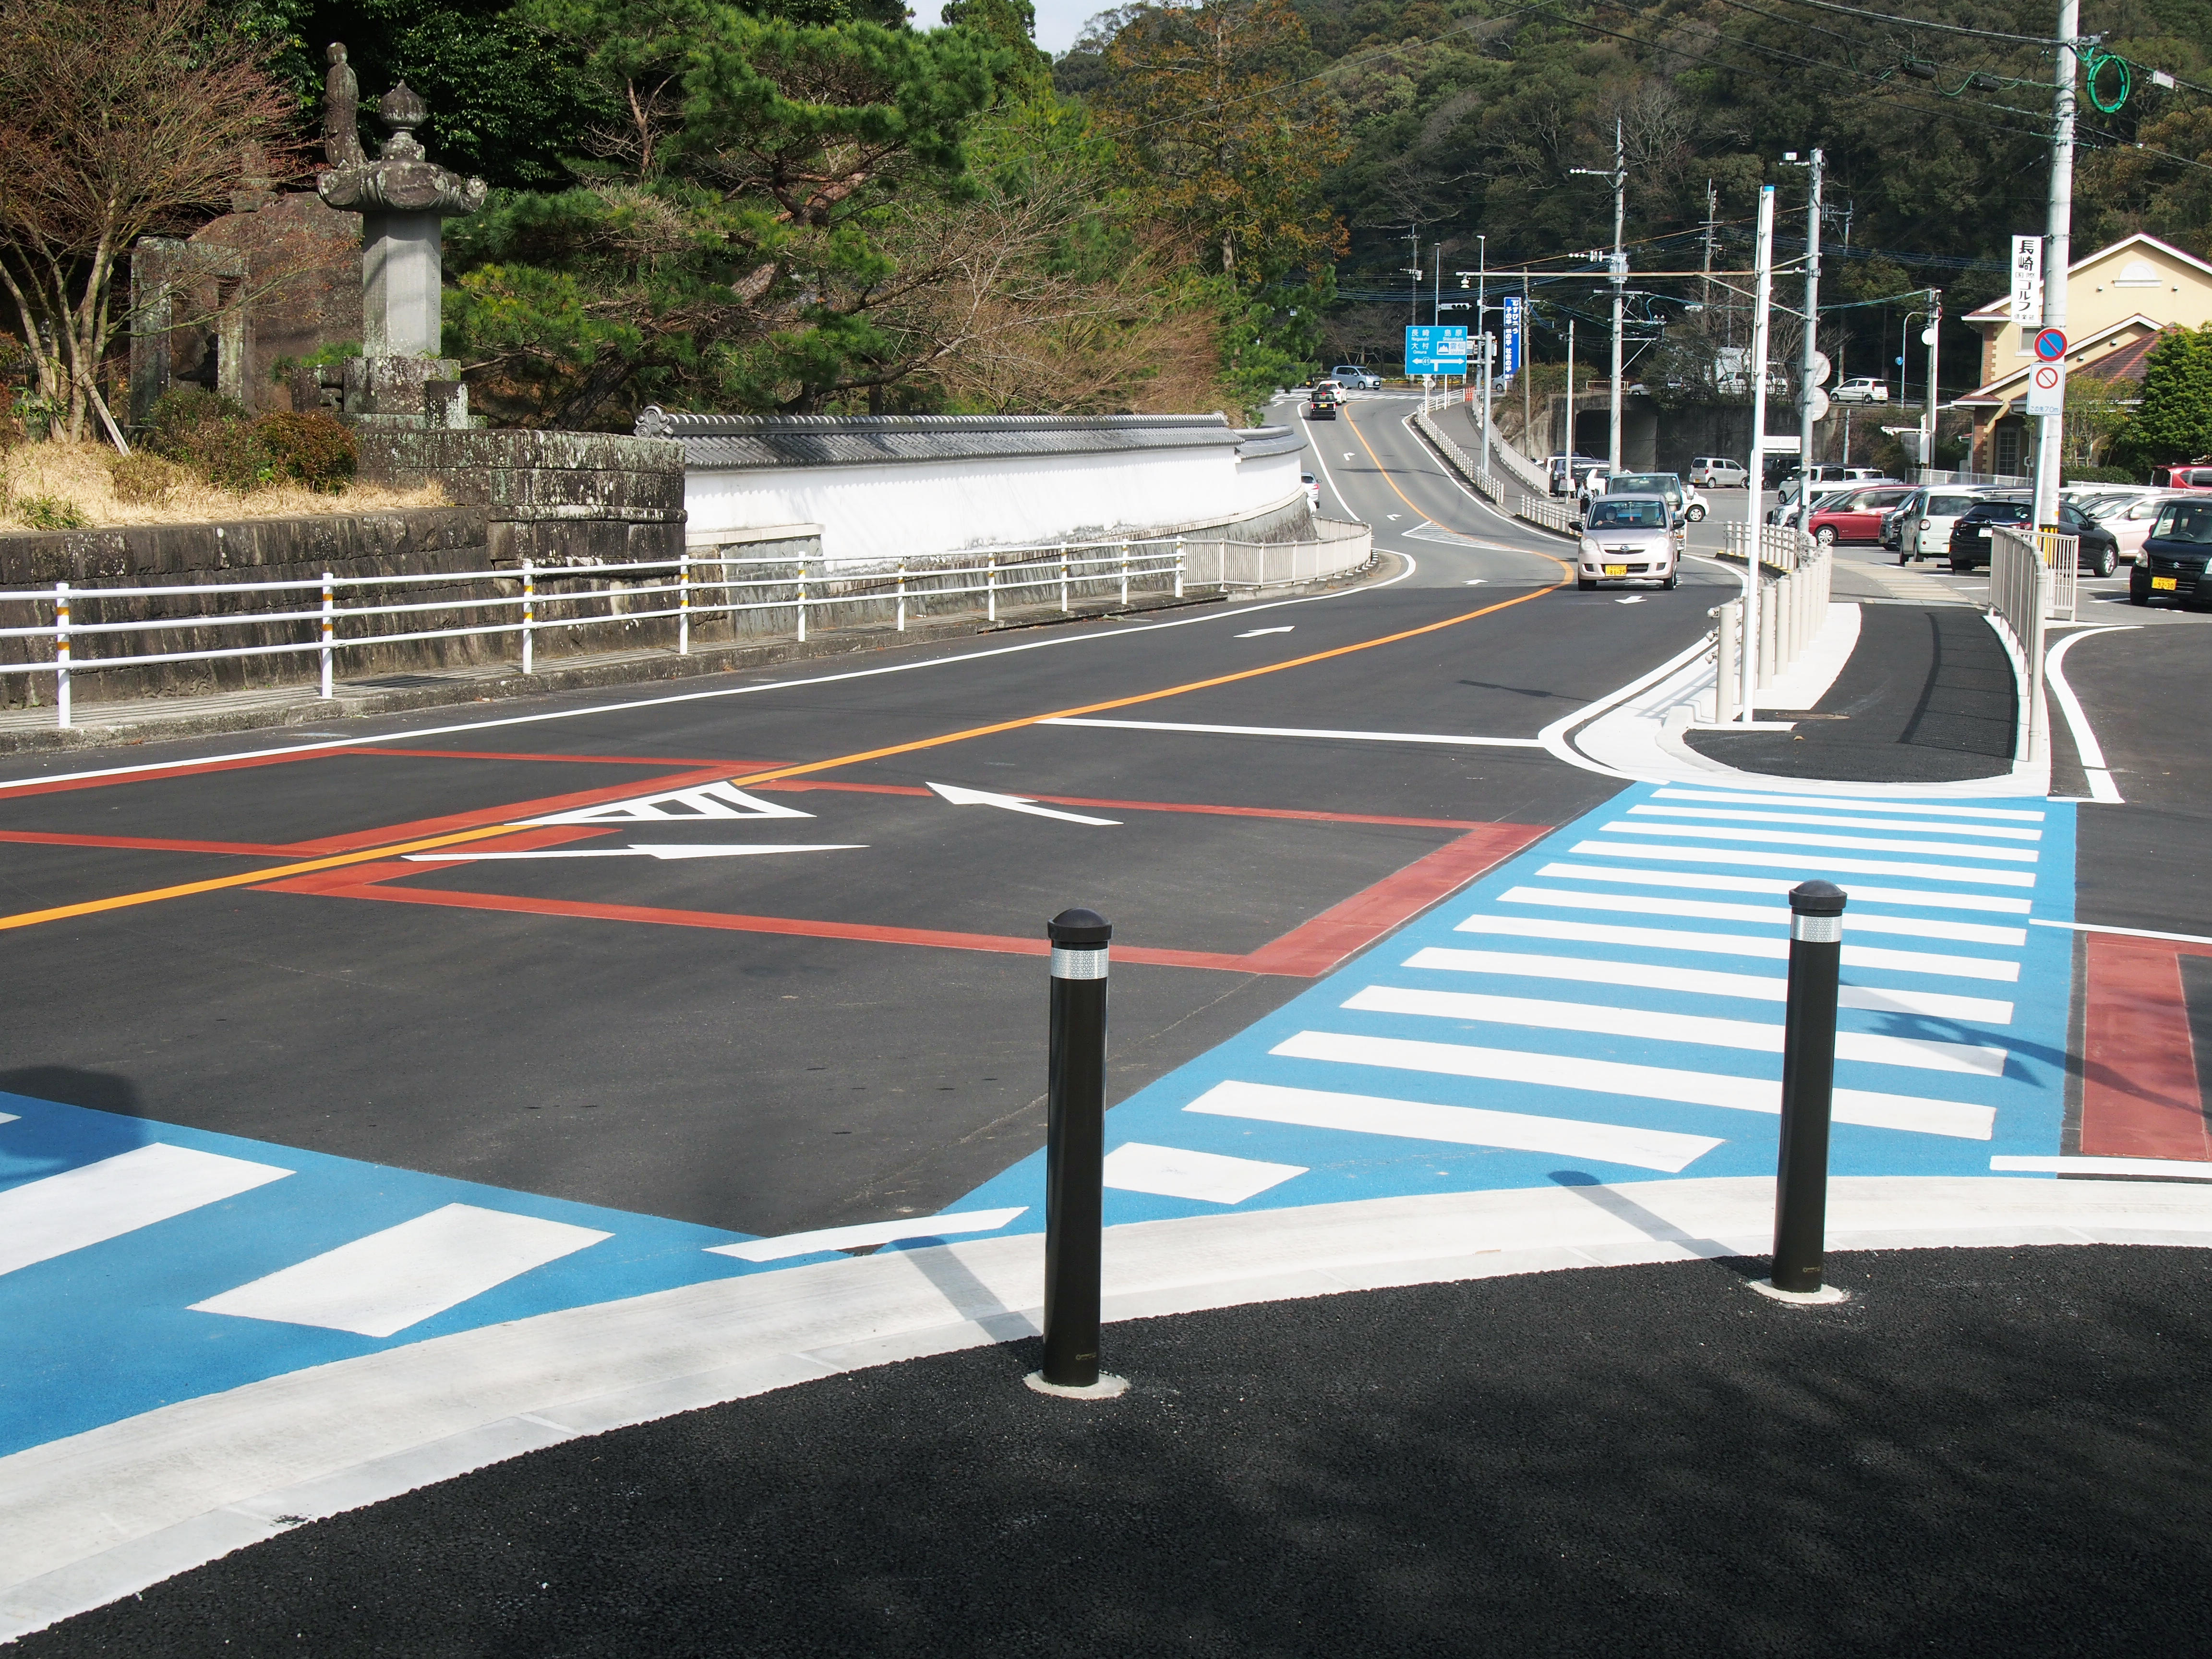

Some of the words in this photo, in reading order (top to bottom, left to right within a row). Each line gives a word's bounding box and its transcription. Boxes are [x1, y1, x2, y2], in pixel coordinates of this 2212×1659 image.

[2019, 240, 2034, 271] 長崎
[2019, 279, 2032, 311] ゴルフ
